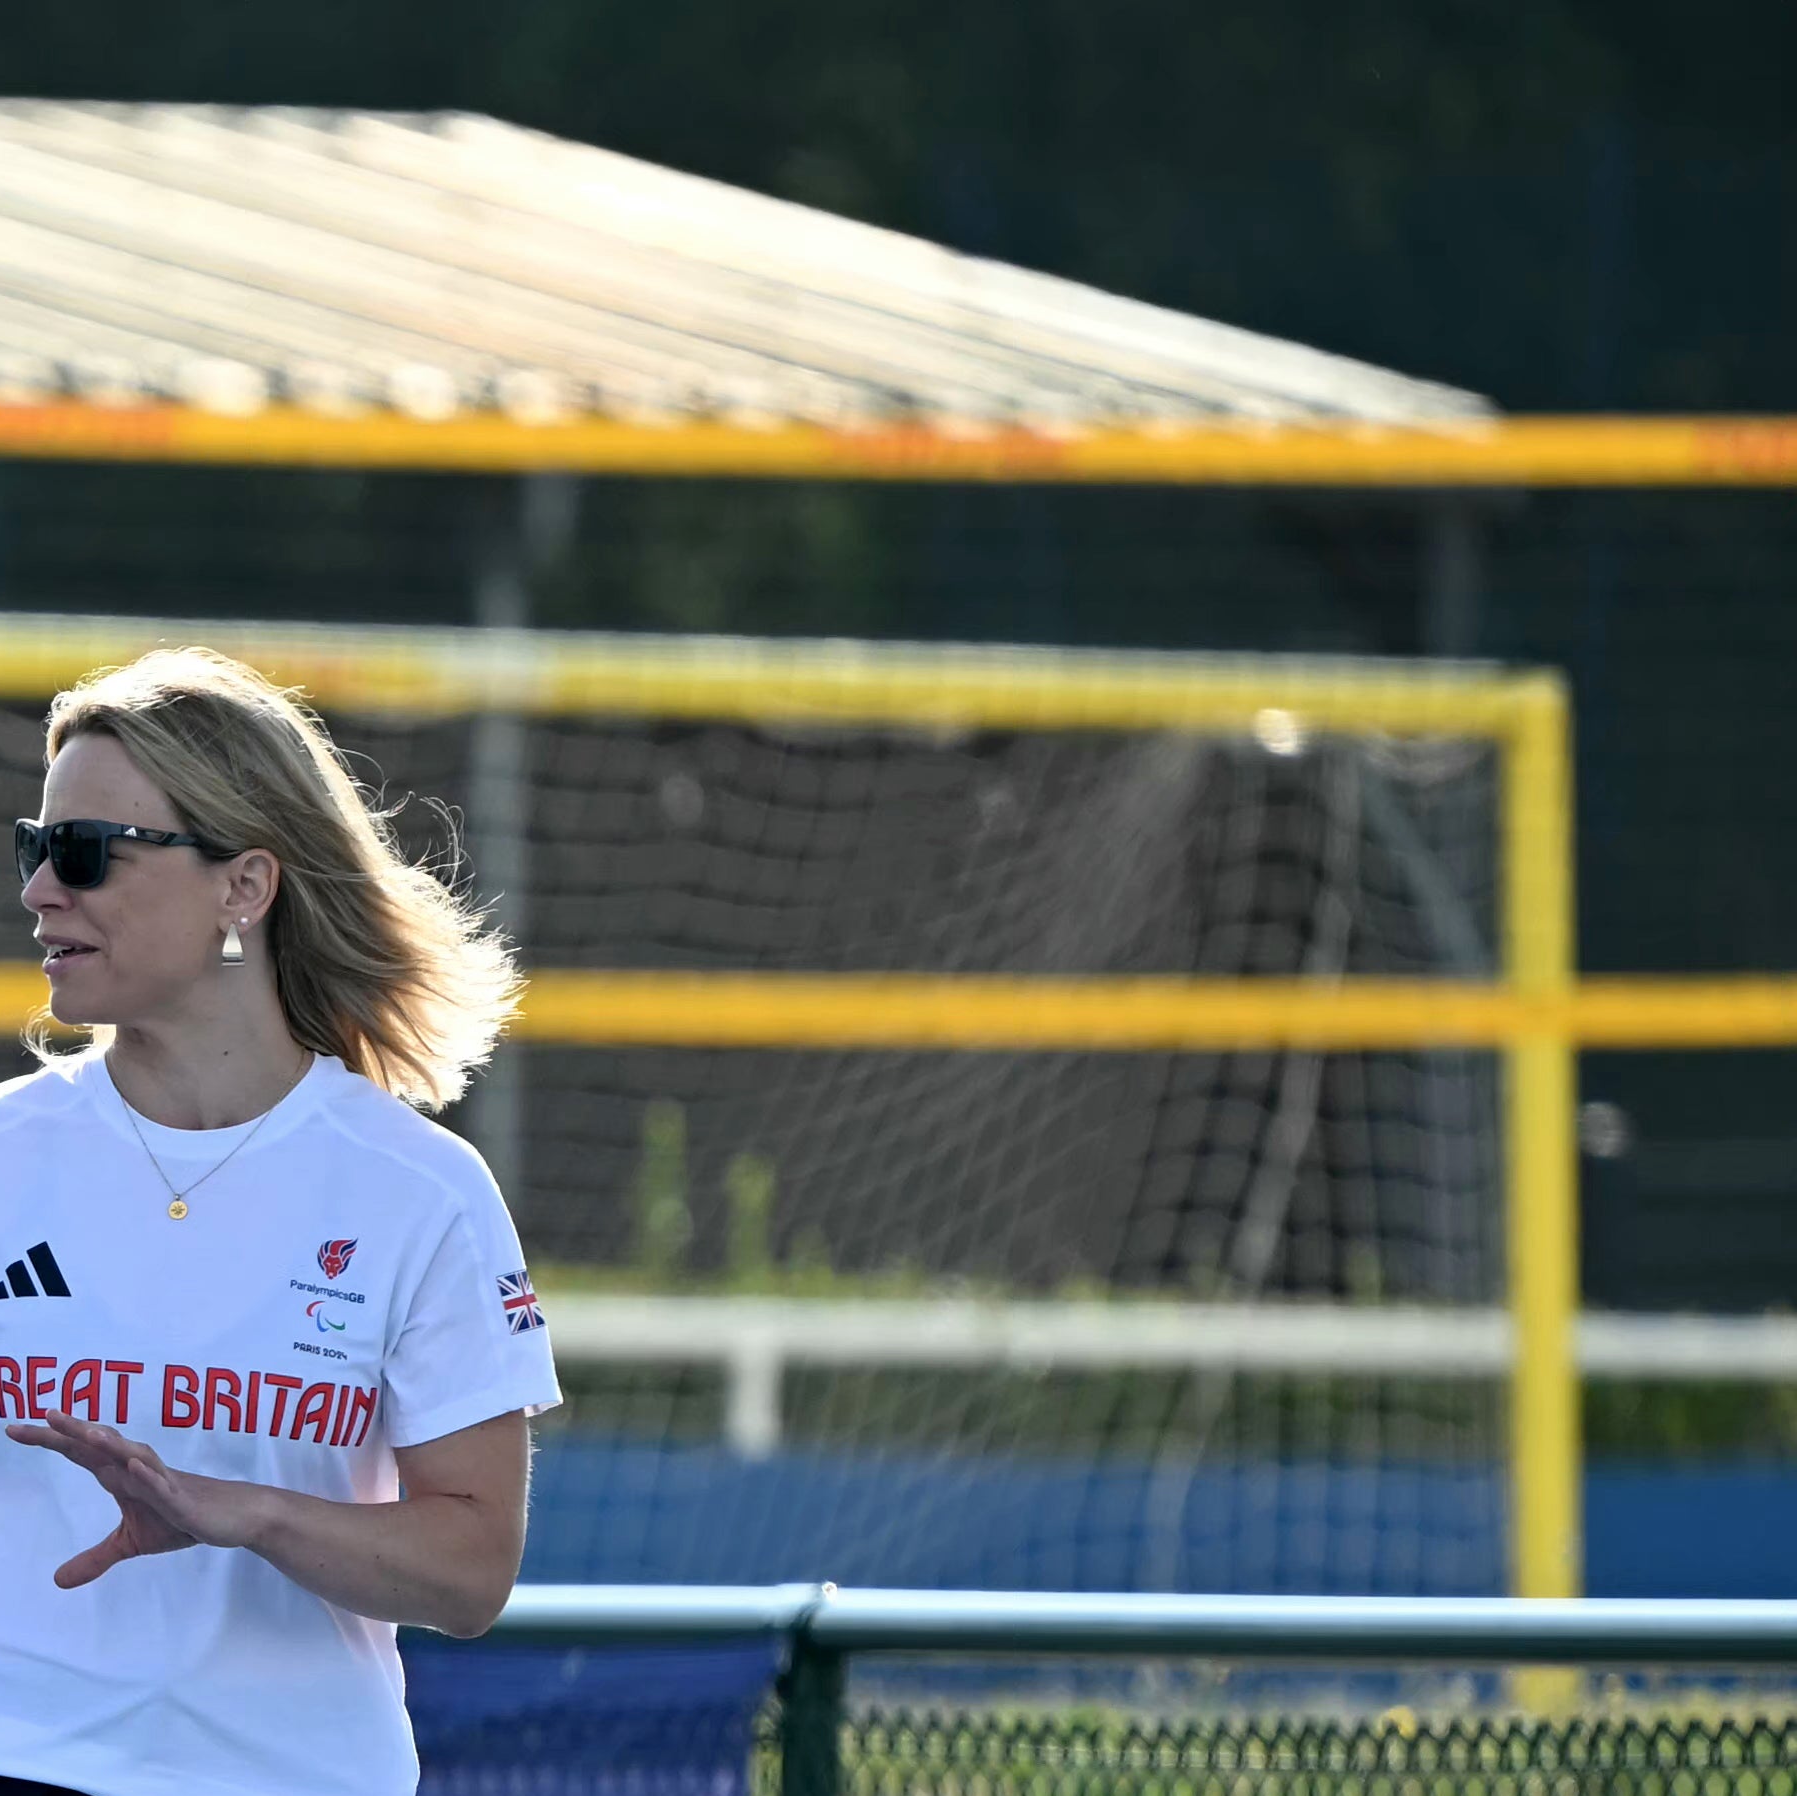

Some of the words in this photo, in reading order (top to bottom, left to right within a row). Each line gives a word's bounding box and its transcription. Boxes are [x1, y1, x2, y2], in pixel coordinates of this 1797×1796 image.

[290, 1279, 366, 1304] ParalympicsGB
[293, 1341, 321, 1355] PARIS
[322, 1347, 348, 1361] 2024
[162, 1364, 378, 1447] BRITAIN
